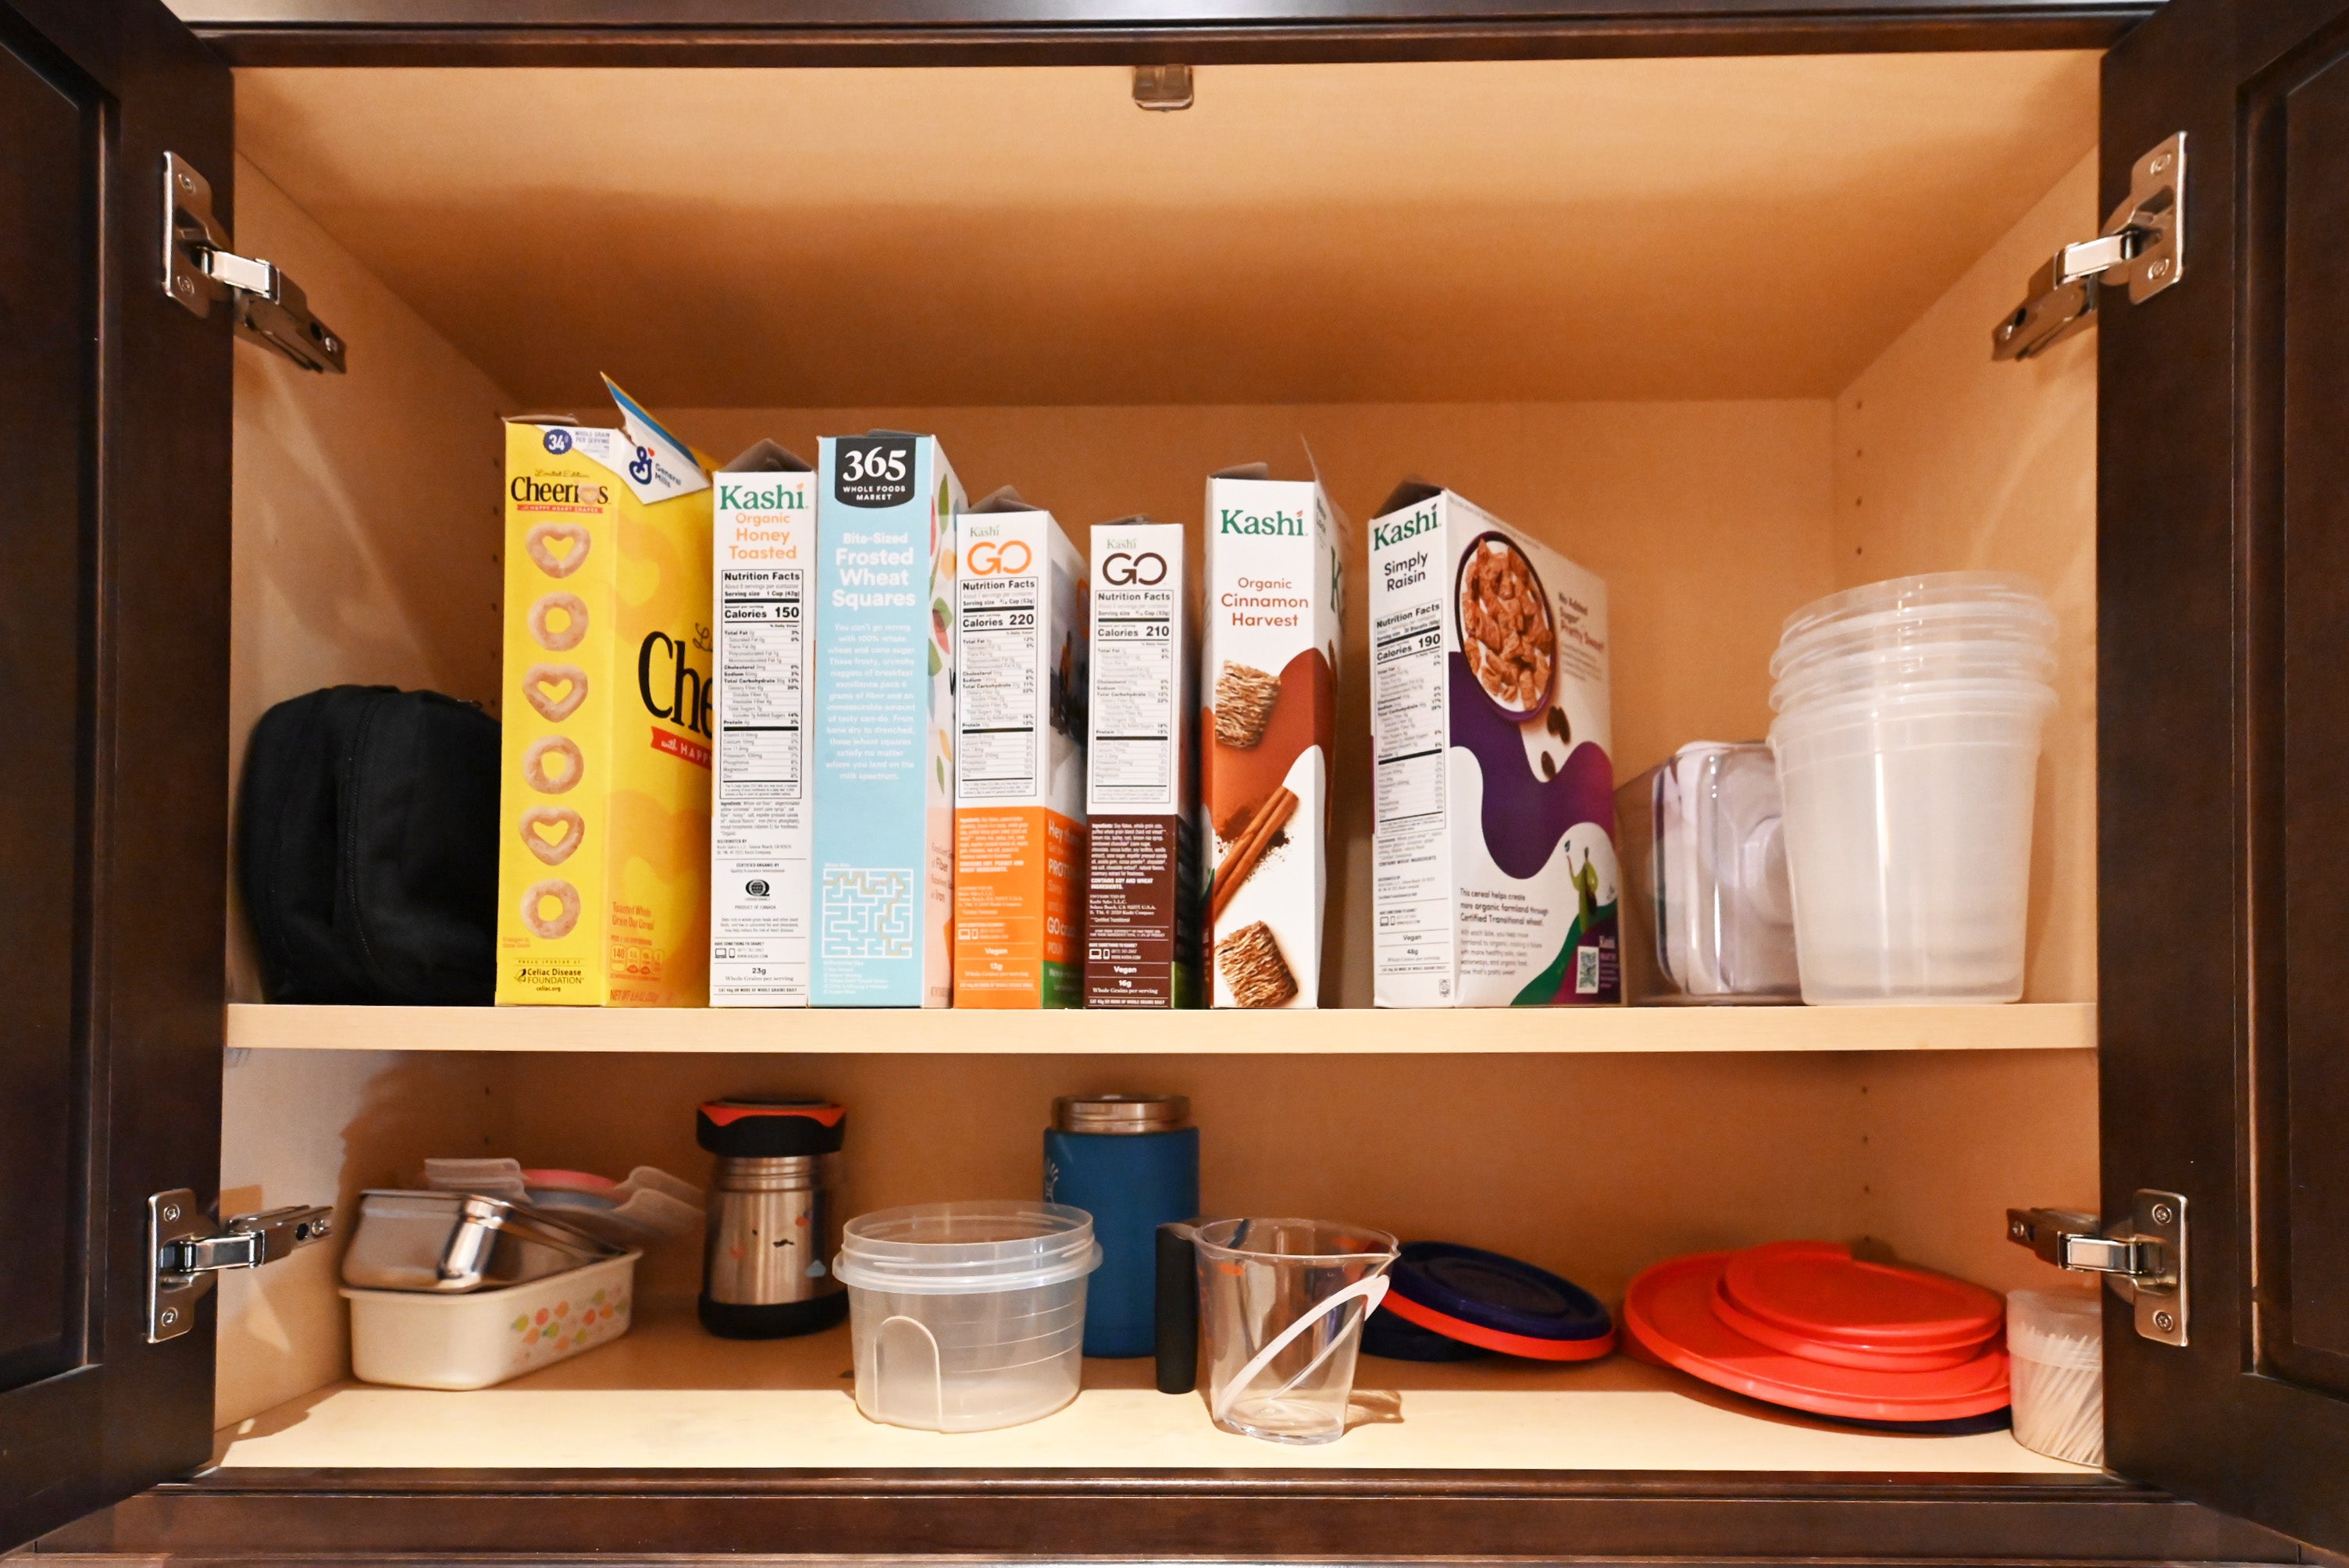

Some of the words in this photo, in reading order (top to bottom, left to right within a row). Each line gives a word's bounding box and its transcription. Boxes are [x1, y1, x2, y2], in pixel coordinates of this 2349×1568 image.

[843, 446, 907, 481] 365
[655, 463, 682, 486] General
[720, 483, 804, 510] Kashi
[736, 511, 790, 527] Organic
[1221, 510, 1304, 536] Kashi
[970, 525, 1000, 537] Kashi
[1374, 503, 1438, 551] Kashi
[736, 527, 790, 545] Honey
[843, 533, 908, 544] Bite-Sized
[1107, 537, 1137, 549] Kashi
[729, 545, 797, 560] Toasted
[836, 547, 914, 566] Frosted
[968, 540, 1032, 576] GO
[1103, 552, 1167, 586] GO
[1384, 551, 1428, 576] Simply
[724, 572, 769, 581] Nutrition
[772, 572, 800, 580] Facts
[839, 568, 910, 586] Wheat
[1387, 570, 1426, 592] Raisin
[962, 581, 1006, 591] Nutrition
[1008, 579, 1035, 589] Facts
[1238, 577, 1292, 592] Organic
[832, 589, 916, 611] Squares
[1098, 593, 1141, 601] Nutrition
[1221, 593, 1310, 608] Cinnamon
[725, 610, 767, 618] Calories
[775, 607, 800, 618] 150
[1232, 613, 1299, 626] Harvest
[1377, 612, 1413, 629] Nutrition
[1416, 604, 1440, 616] Facts
[963, 618, 1003, 628] Calories
[1009, 614, 1035, 625] 220
[1146, 625, 1169, 636] 210
[1377, 644, 1413, 661] Calories
[1418, 633, 1441, 649] 190
[661, 739, 677, 751] with
[1474, 901, 1499, 913] organic
[1501, 901, 1529, 914] farmland
[1460, 912, 1488, 923] Certified
[1488, 914, 1524, 925] Transitional
[985, 947, 1008, 957] Vegan
[1114, 965, 1138, 975] Vegan
[1118, 979, 1132, 989] 16g
